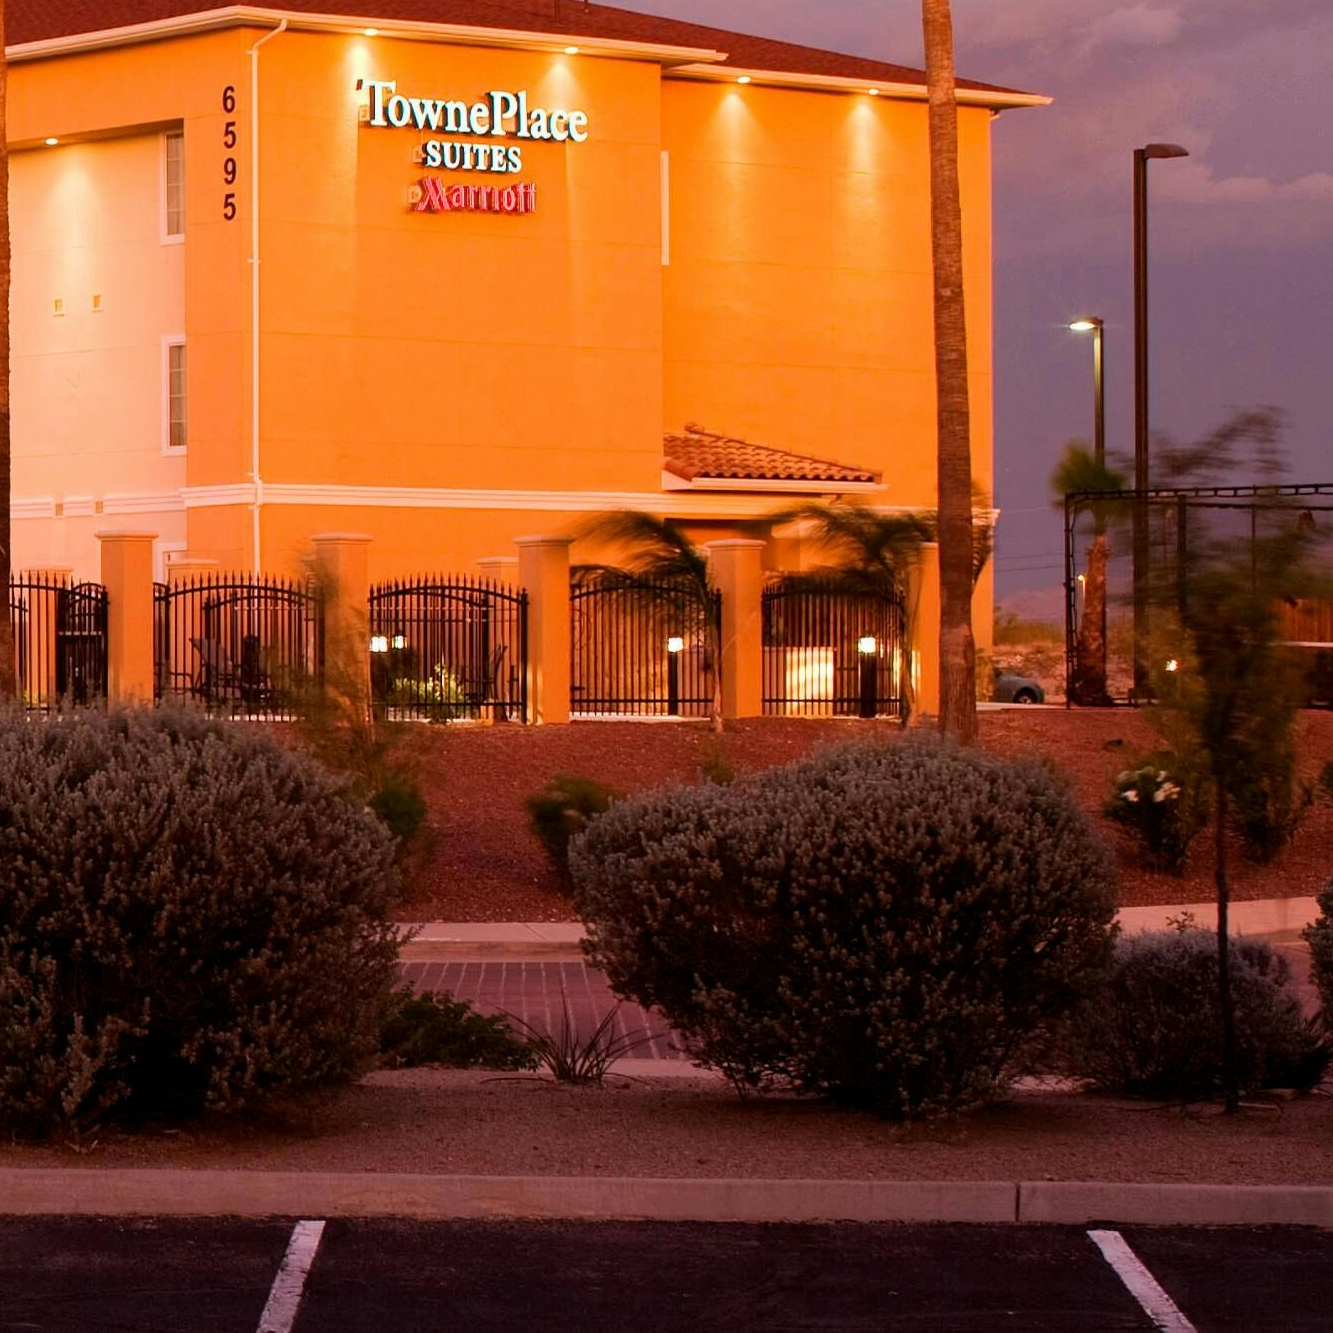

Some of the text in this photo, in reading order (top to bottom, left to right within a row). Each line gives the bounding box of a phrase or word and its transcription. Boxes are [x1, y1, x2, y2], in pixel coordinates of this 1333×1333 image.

[360, 79, 589, 143] TownePlace
[222, 85, 237, 221] 6595
[425, 139, 522, 174] SUITES
[414, 176, 537, 213] Marriott
